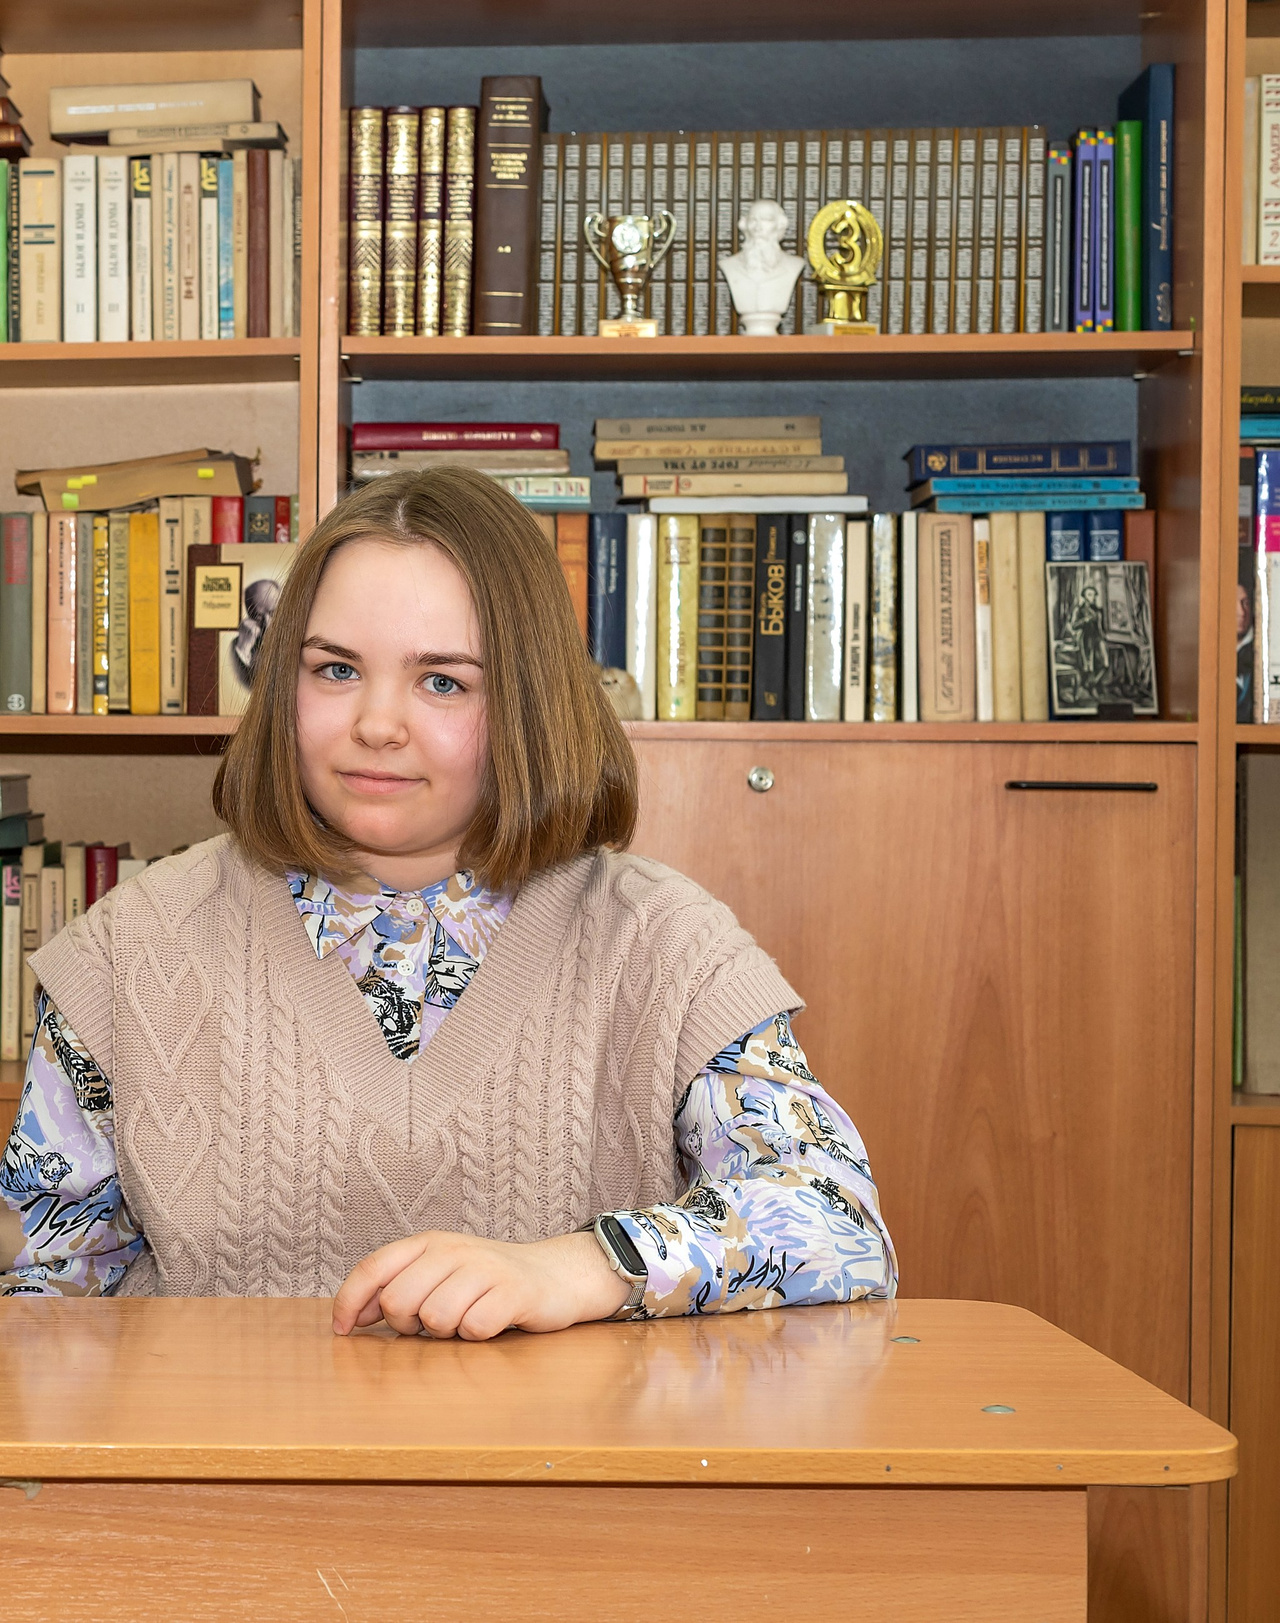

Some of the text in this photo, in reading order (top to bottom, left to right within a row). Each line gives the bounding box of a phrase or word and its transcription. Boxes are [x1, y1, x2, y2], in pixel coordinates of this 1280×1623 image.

[940, 529, 952, 605] КАРЕНИНА
[940, 608, 952, 648] АННА
[7, 693, 26, 711] 3
